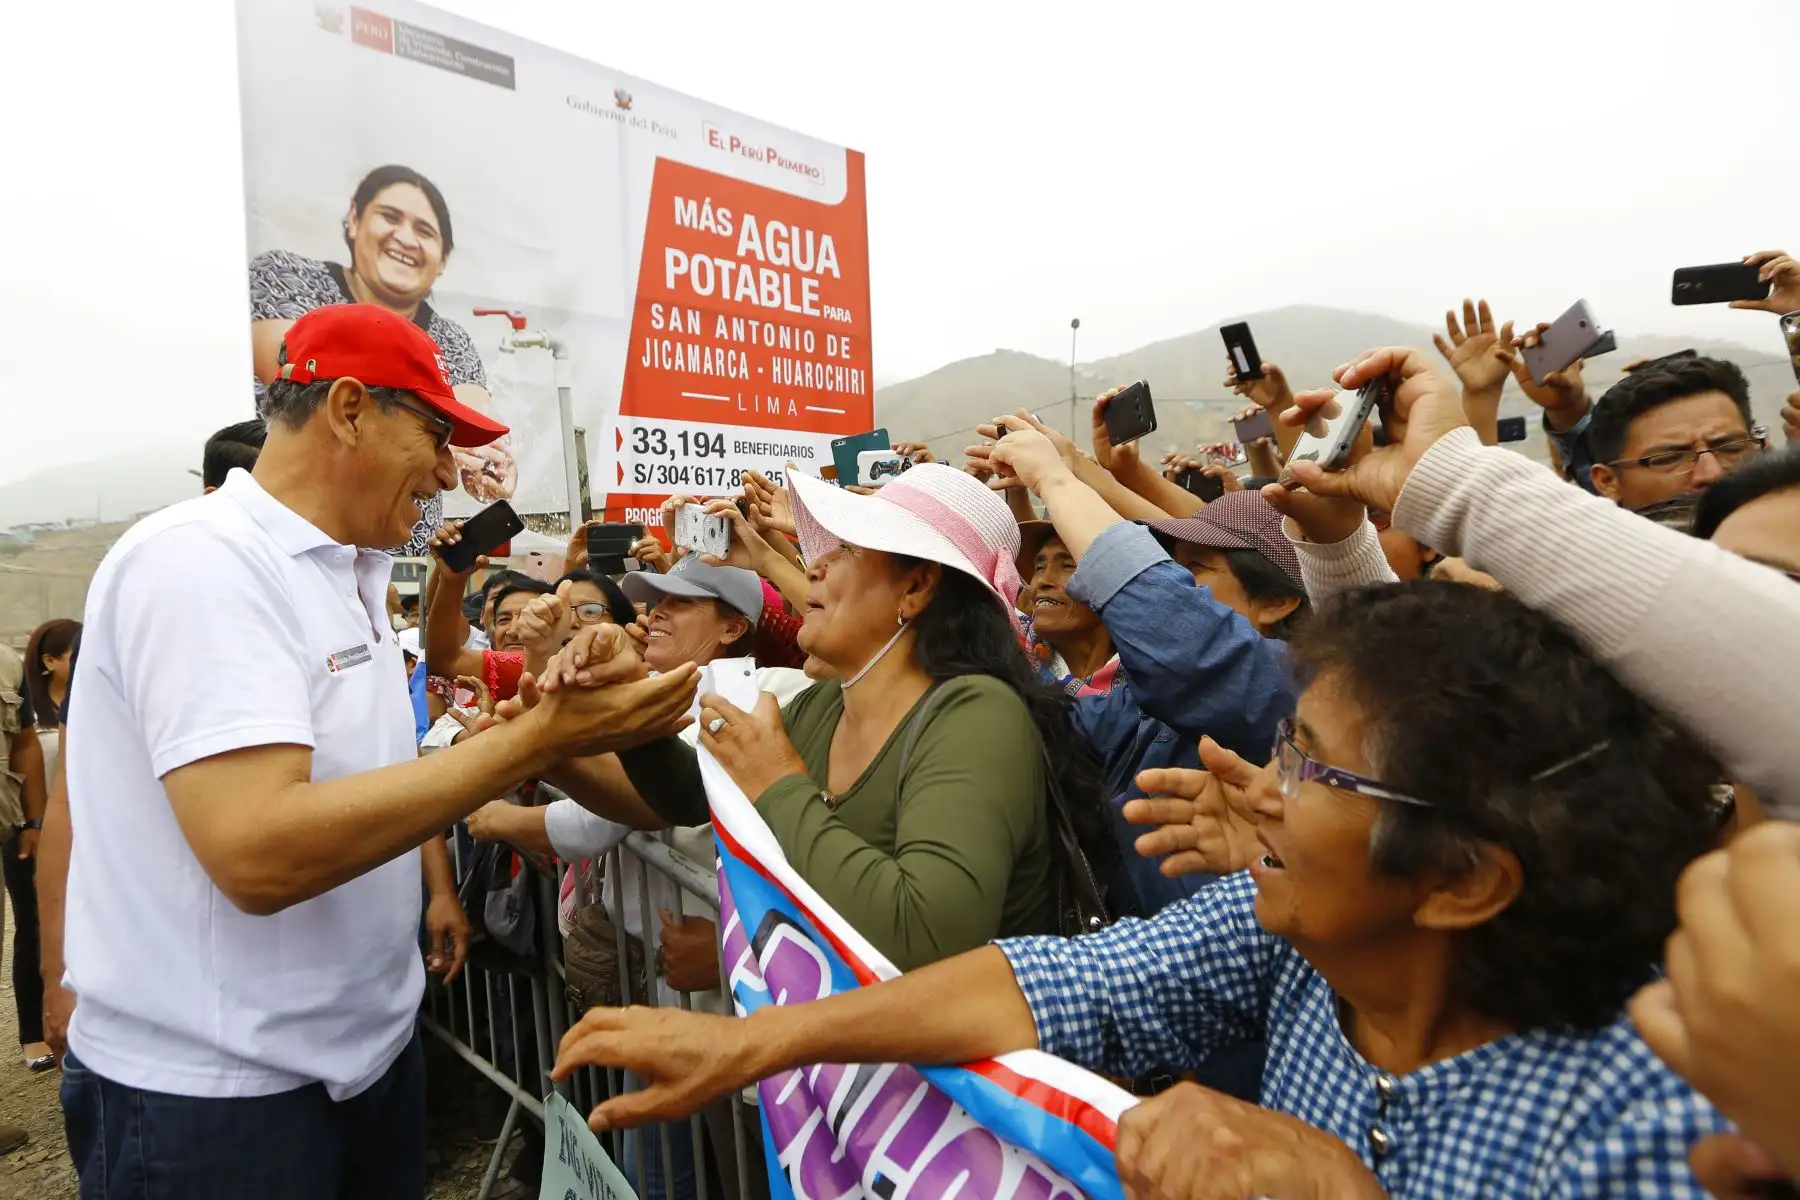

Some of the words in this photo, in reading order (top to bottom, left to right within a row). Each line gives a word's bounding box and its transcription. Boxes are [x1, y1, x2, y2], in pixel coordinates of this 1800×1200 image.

[566, 94, 626, 123] Gobierno
[628, 116, 648, 131] del
[651, 120, 678, 139] Perú
[708, 128, 727, 150] EL
[730, 135, 763, 162] PERÚ
[766, 147, 820, 179] PRIMERO
[674, 196, 733, 237] MÁS
[737, 213, 841, 279] AGUA
[665, 247, 820, 317] POTABLE
[823, 304, 852, 324] PARA
[651, 303, 701, 335] SAN
[715, 314, 815, 353] ANTONIO
[827, 333, 851, 359] DE
[642, 338, 749, 380] JICAMARCA
[772, 356, 866, 395] HUAROCHIRI
[738, 394, 798, 416] LIMA
[632, 426, 726, 461] 33,194
[734, 440, 814, 459] BENEFICIARIOS
